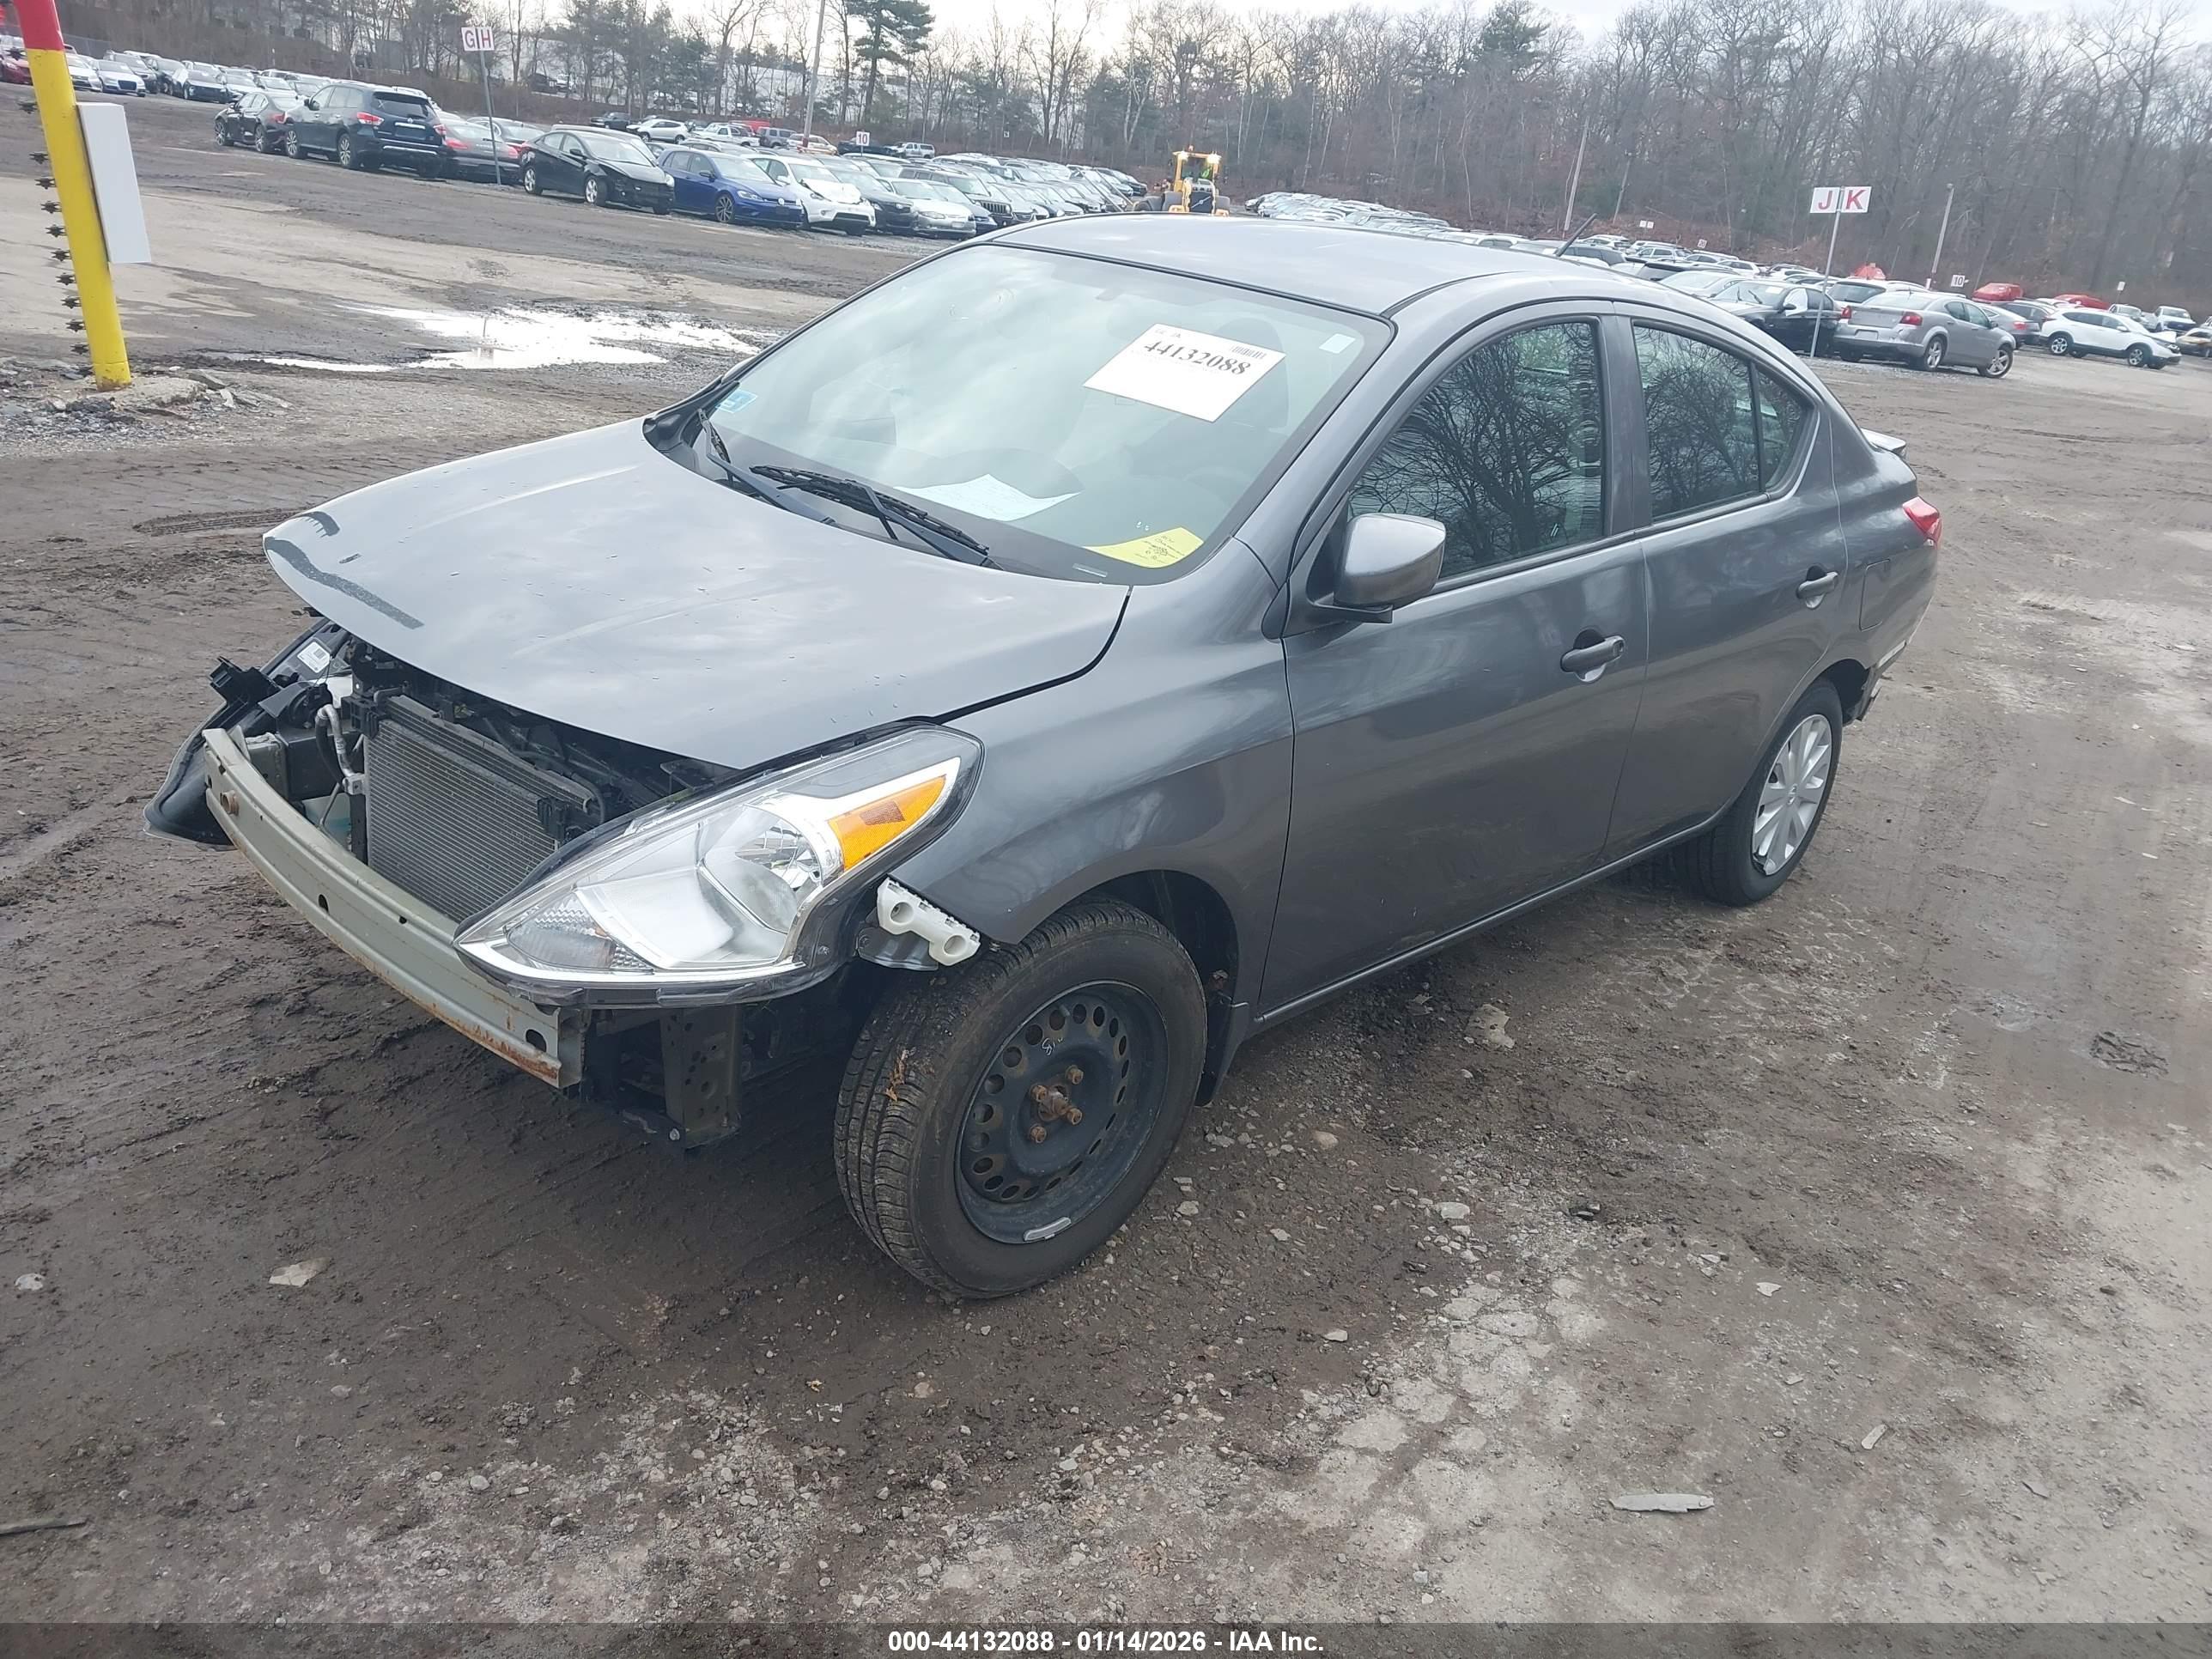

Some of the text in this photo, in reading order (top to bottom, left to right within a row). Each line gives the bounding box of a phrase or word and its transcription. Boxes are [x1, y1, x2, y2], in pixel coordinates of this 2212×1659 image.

[858, 133, 867, 144] 10
[1818, 189, 1866, 210] J K
[1954, 276, 1964, 286] 10
[1144, 341, 1251, 375] 44132088
